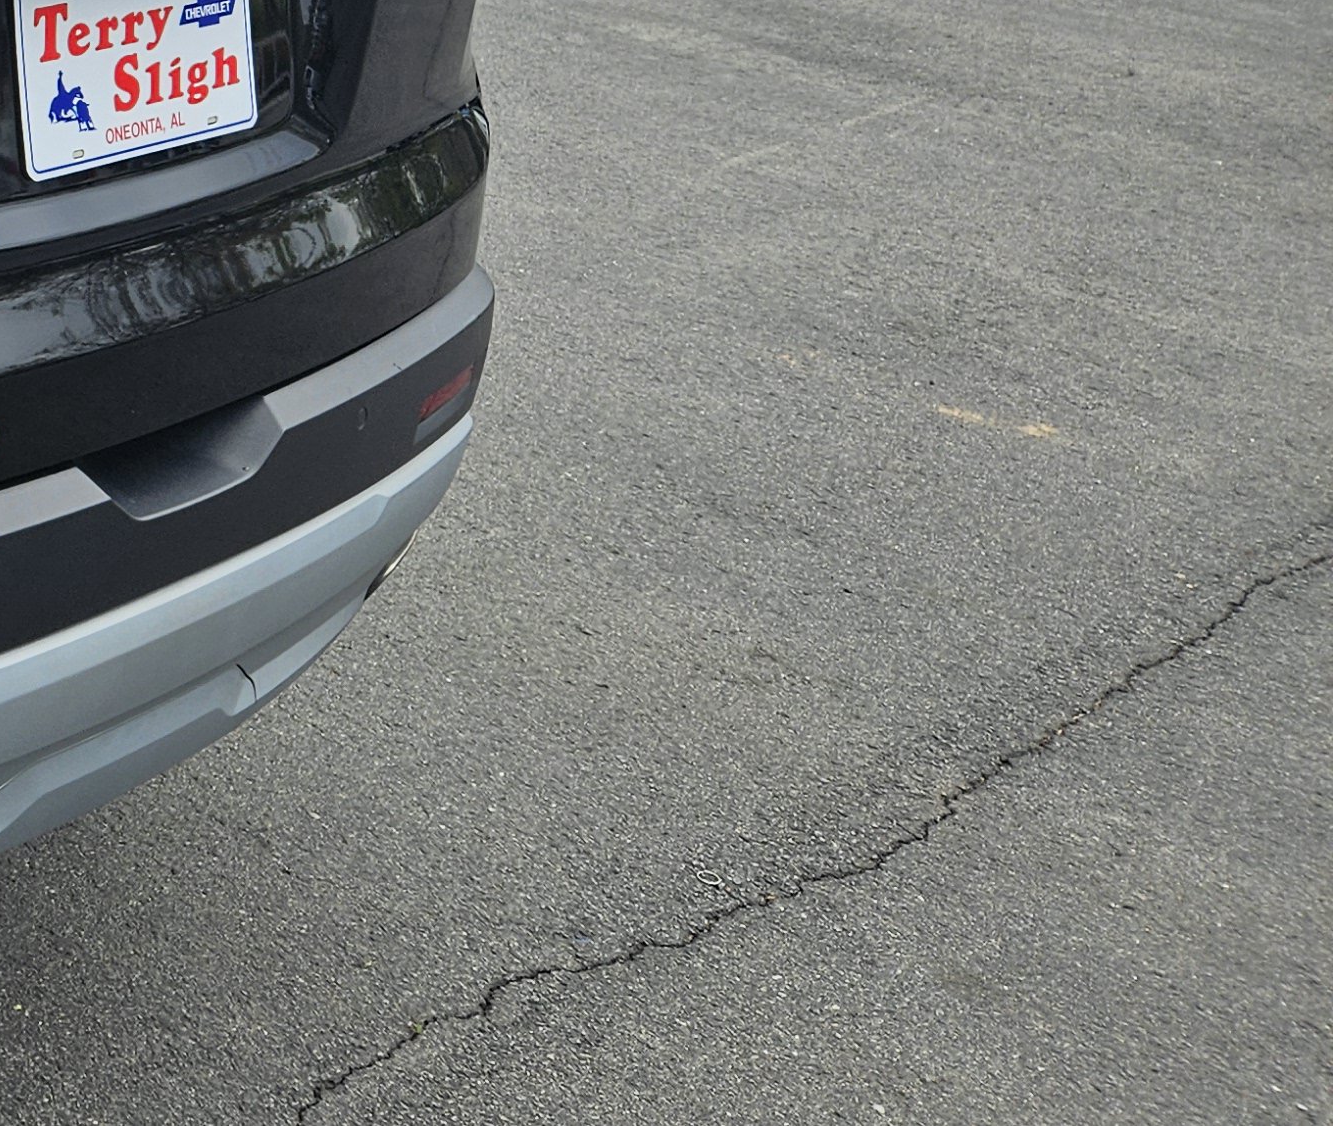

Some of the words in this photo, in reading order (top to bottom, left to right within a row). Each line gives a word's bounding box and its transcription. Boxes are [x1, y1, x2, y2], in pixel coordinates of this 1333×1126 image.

[34, 3, 174, 63] Terry
[184, 0, 231, 21] CHEVROLET
[113, 47, 240, 113] Sligh
[105, 118, 166, 145] ONEONTA,
[170, 113, 186, 129] AL
